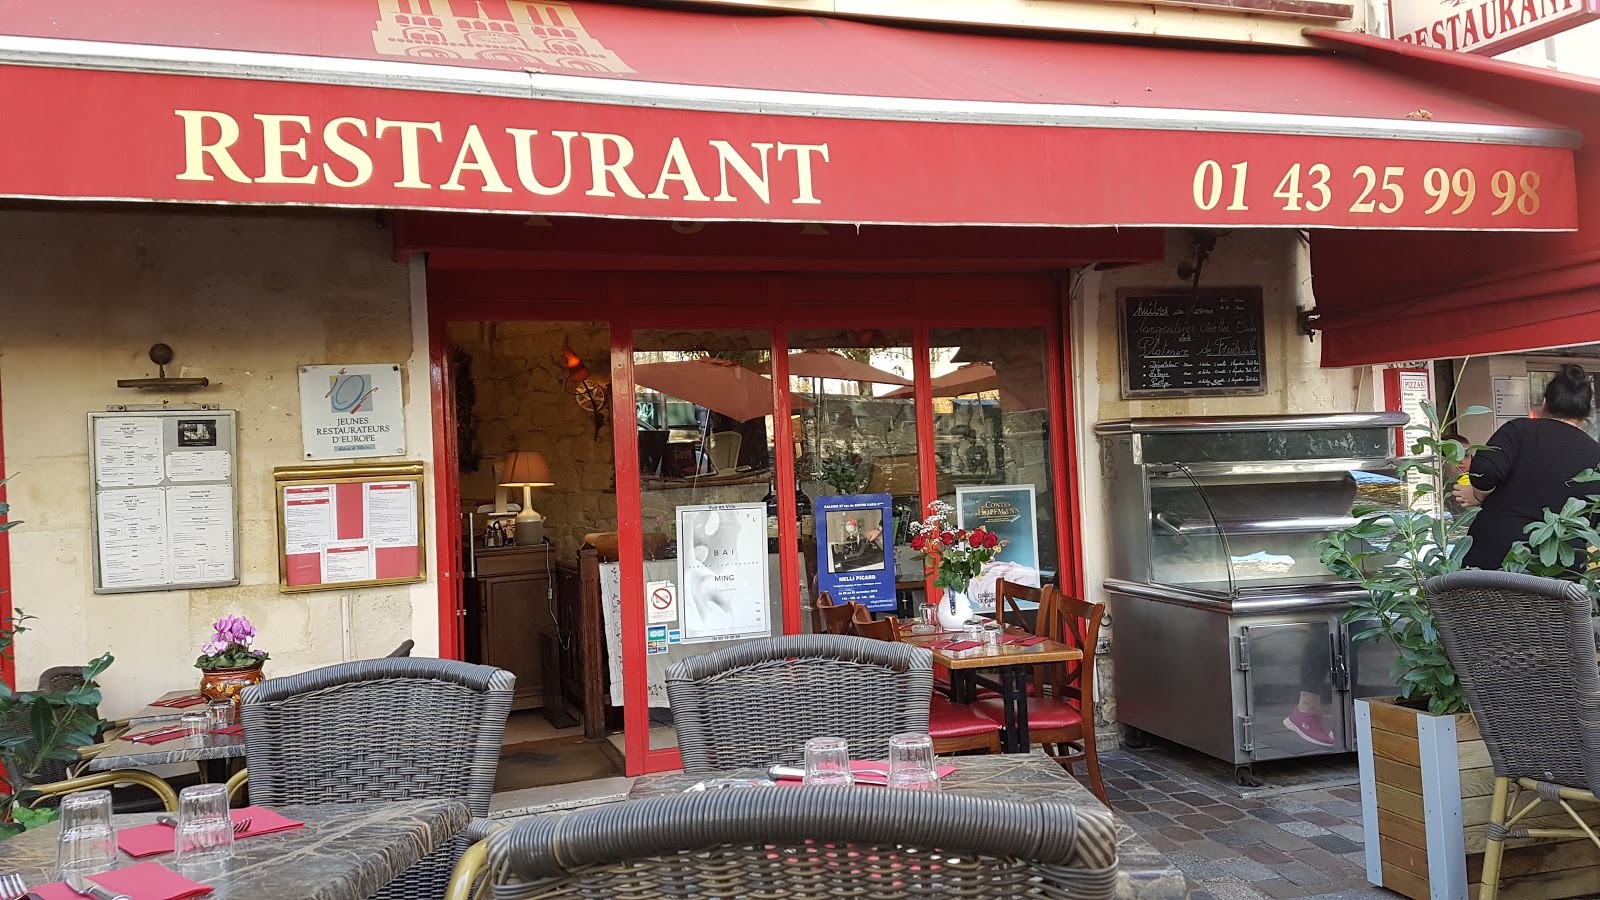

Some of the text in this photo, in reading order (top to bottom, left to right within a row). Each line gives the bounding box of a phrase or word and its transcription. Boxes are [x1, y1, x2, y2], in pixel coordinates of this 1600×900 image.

[1399, 0, 1573, 51] ESTAURA
[175, 110, 830, 206] RESTAURANT
[1193, 160, 1541, 216] 01 43 25 99 98
[1404, 381, 1425, 390] PIZZAS
[337, 417, 369, 427] JEUNES
[316, 425, 390, 435] RESTAURATEURS
[332, 434, 376, 443] D'EUROPE
[984, 500, 1012, 509] CONTES
[977, 507, 1020, 517] HOFFMANN
